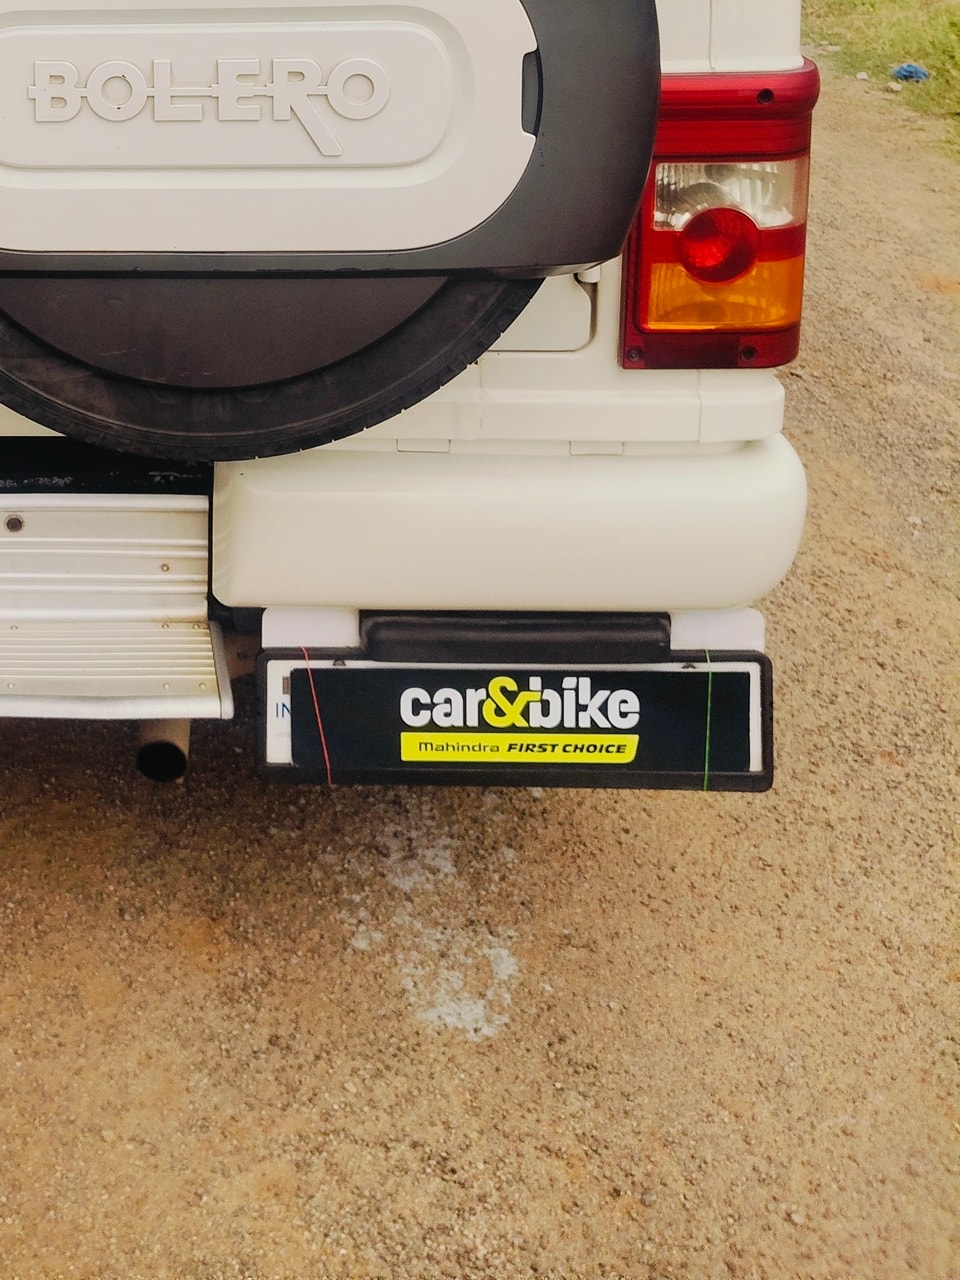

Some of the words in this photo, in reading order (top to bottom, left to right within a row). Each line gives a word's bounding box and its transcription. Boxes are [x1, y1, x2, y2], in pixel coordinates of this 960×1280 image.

[28, 57, 391, 156] BOLERO
[400, 676, 640, 729] car&bike
[418, 741, 500, 753] Mahindra
[507, 743, 558, 754] FIRST
[562, 743, 628, 754] CHOICE
